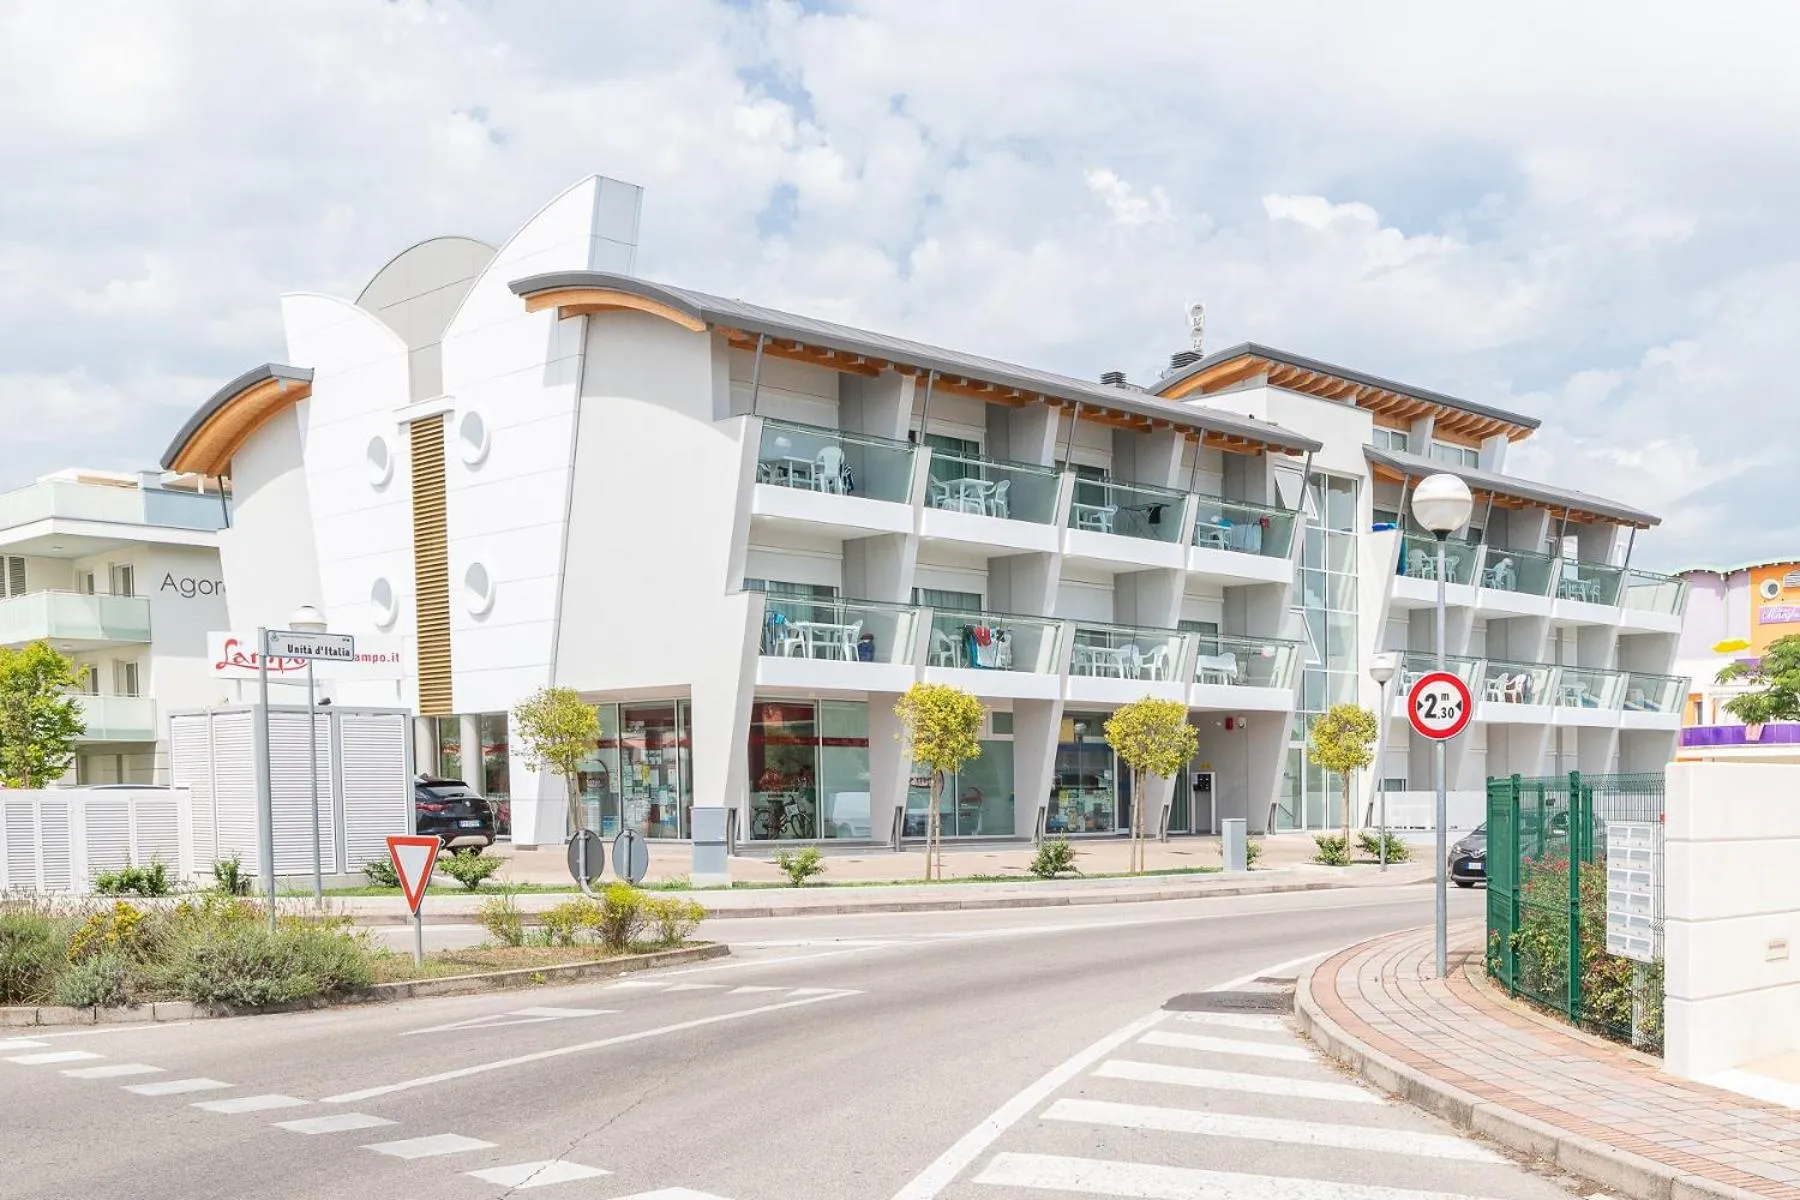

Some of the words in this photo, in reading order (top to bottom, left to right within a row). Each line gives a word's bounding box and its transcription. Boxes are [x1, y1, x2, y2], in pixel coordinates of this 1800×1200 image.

[160, 571, 226, 599] Agor
[315, 645, 350, 657] d'Italia
[353, 652, 400, 664] ampo.it
